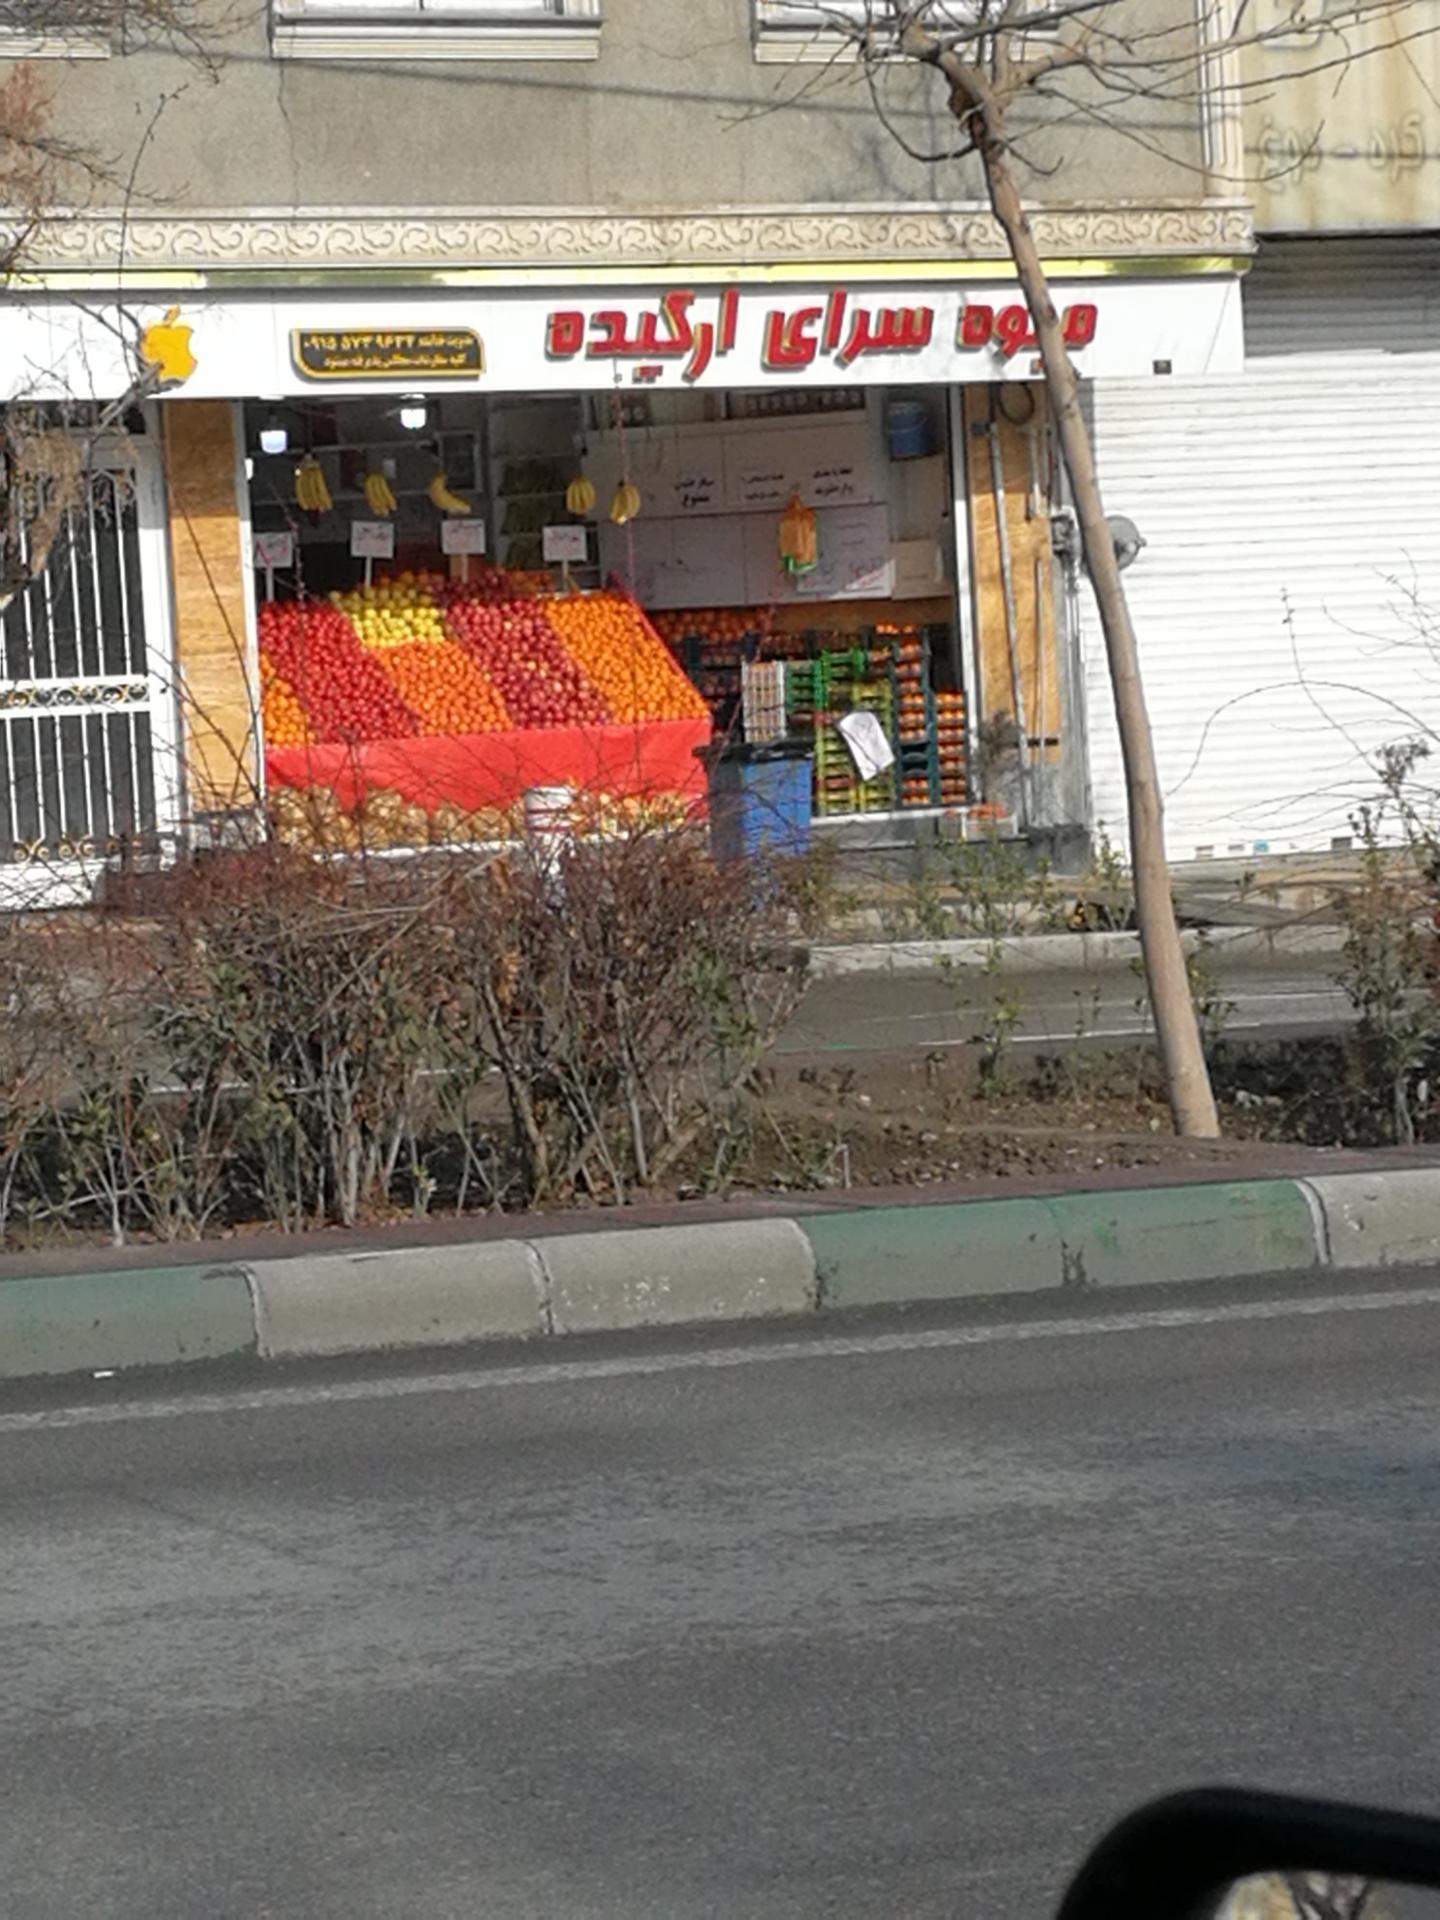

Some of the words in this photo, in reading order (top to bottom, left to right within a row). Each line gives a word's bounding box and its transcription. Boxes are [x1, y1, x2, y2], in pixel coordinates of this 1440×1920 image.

[546, 288, 740, 382] ارکیده
[761, 289, 934, 368] سرای
[955, 303, 1098, 374] موه
